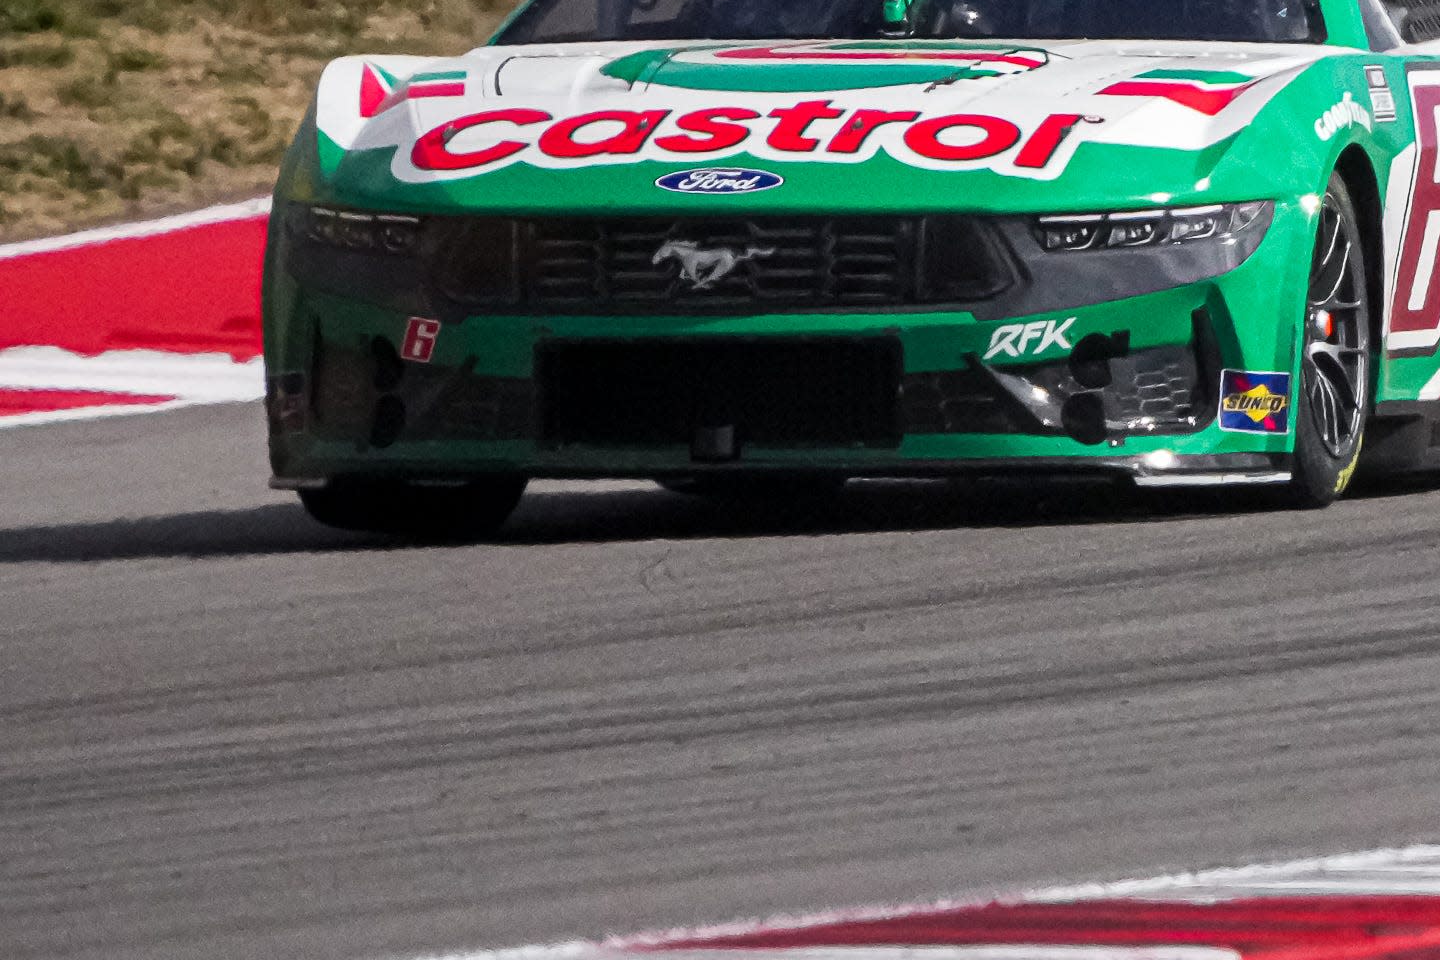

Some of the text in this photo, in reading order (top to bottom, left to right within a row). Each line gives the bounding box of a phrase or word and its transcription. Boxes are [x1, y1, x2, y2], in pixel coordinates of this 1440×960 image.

[410, 99, 1082, 172] Castrol
[402, 314, 440, 362] 6
[983, 316, 1077, 360] RFK
